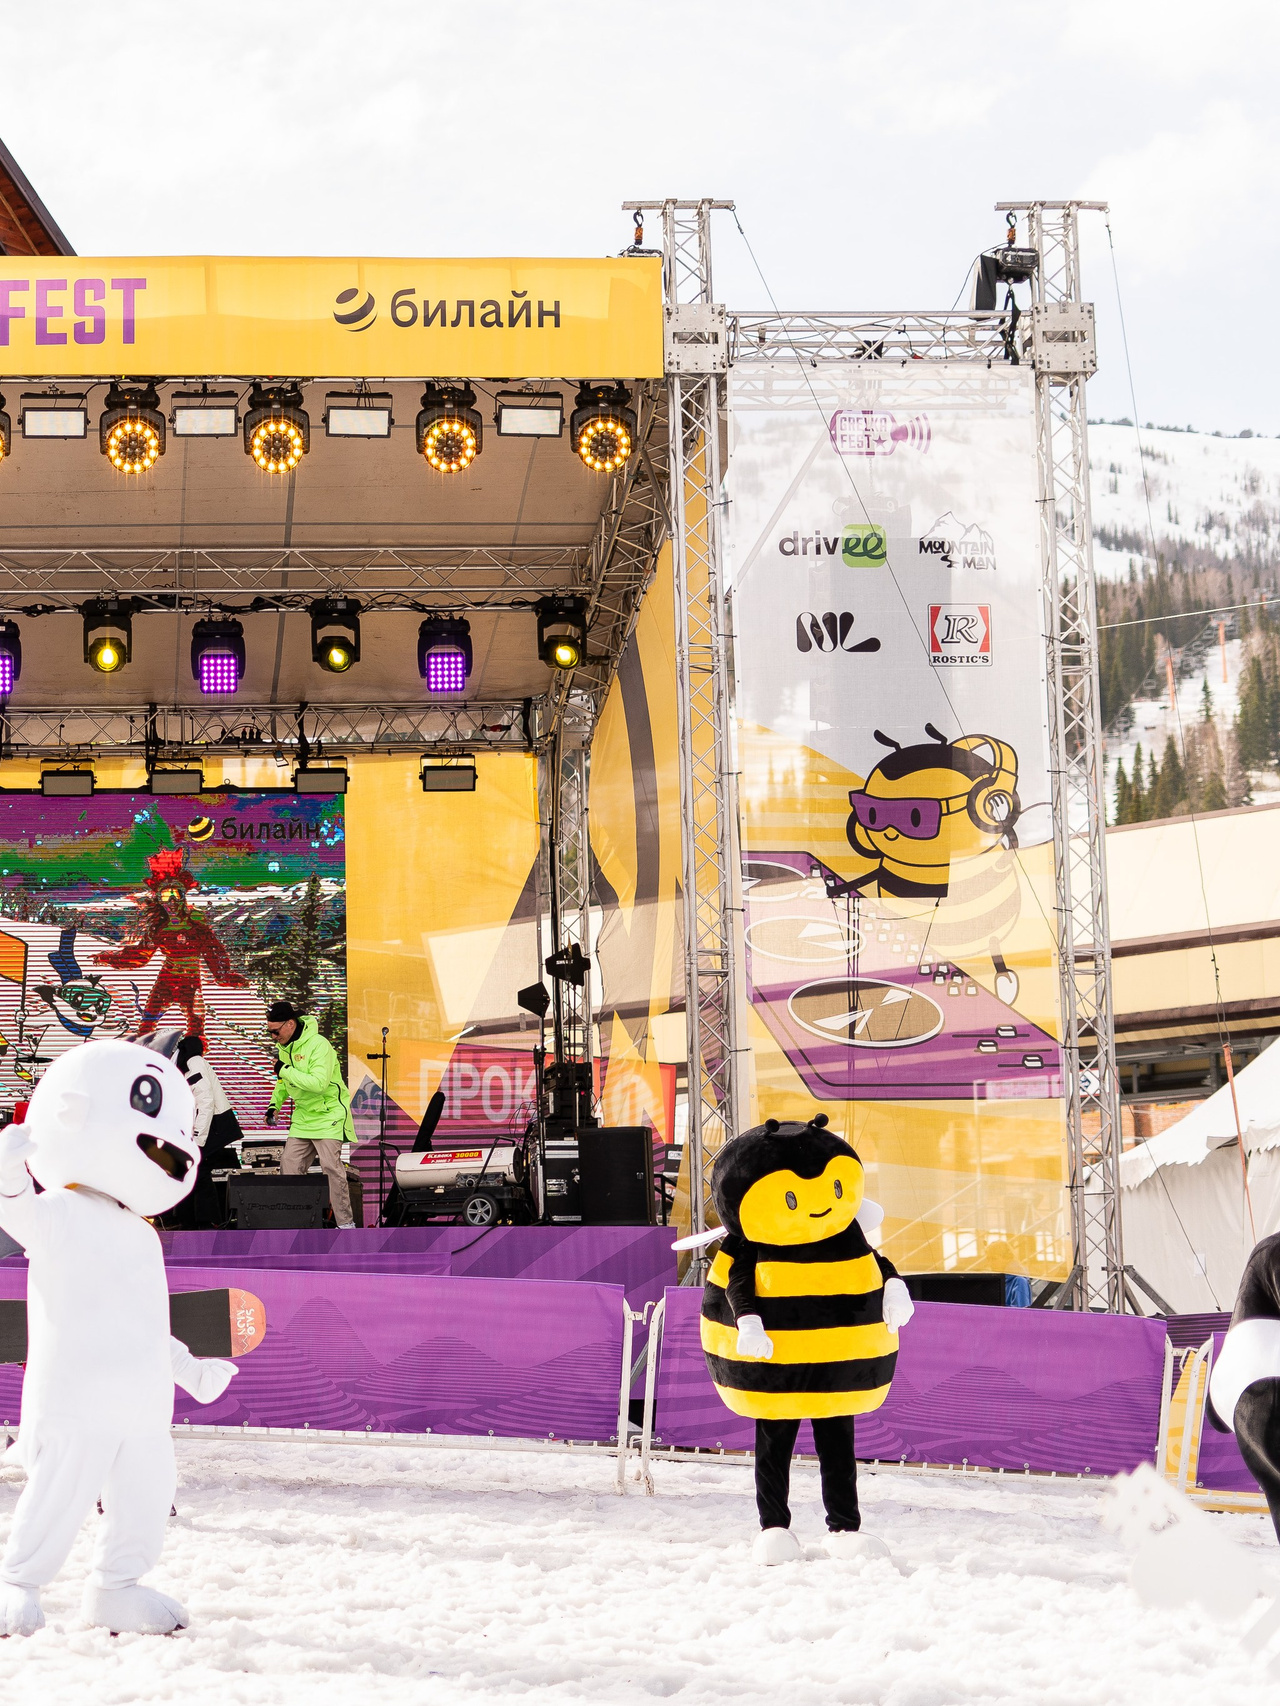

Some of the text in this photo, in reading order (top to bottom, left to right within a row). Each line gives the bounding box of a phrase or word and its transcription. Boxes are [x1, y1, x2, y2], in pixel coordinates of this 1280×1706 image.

[389, 287, 561, 328] билайн
[839, 416, 888, 431] GRELKA
[840, 433, 872, 449] FEST
[778, 530, 887, 560] drivee
[919, 539, 995, 556] MOUNTAIN
[962, 556, 997, 570] MAN
[932, 655, 990, 664] ROSTIC'S
[220, 816, 321, 841] билайн
[455, 1151, 480, 1159] 30000
